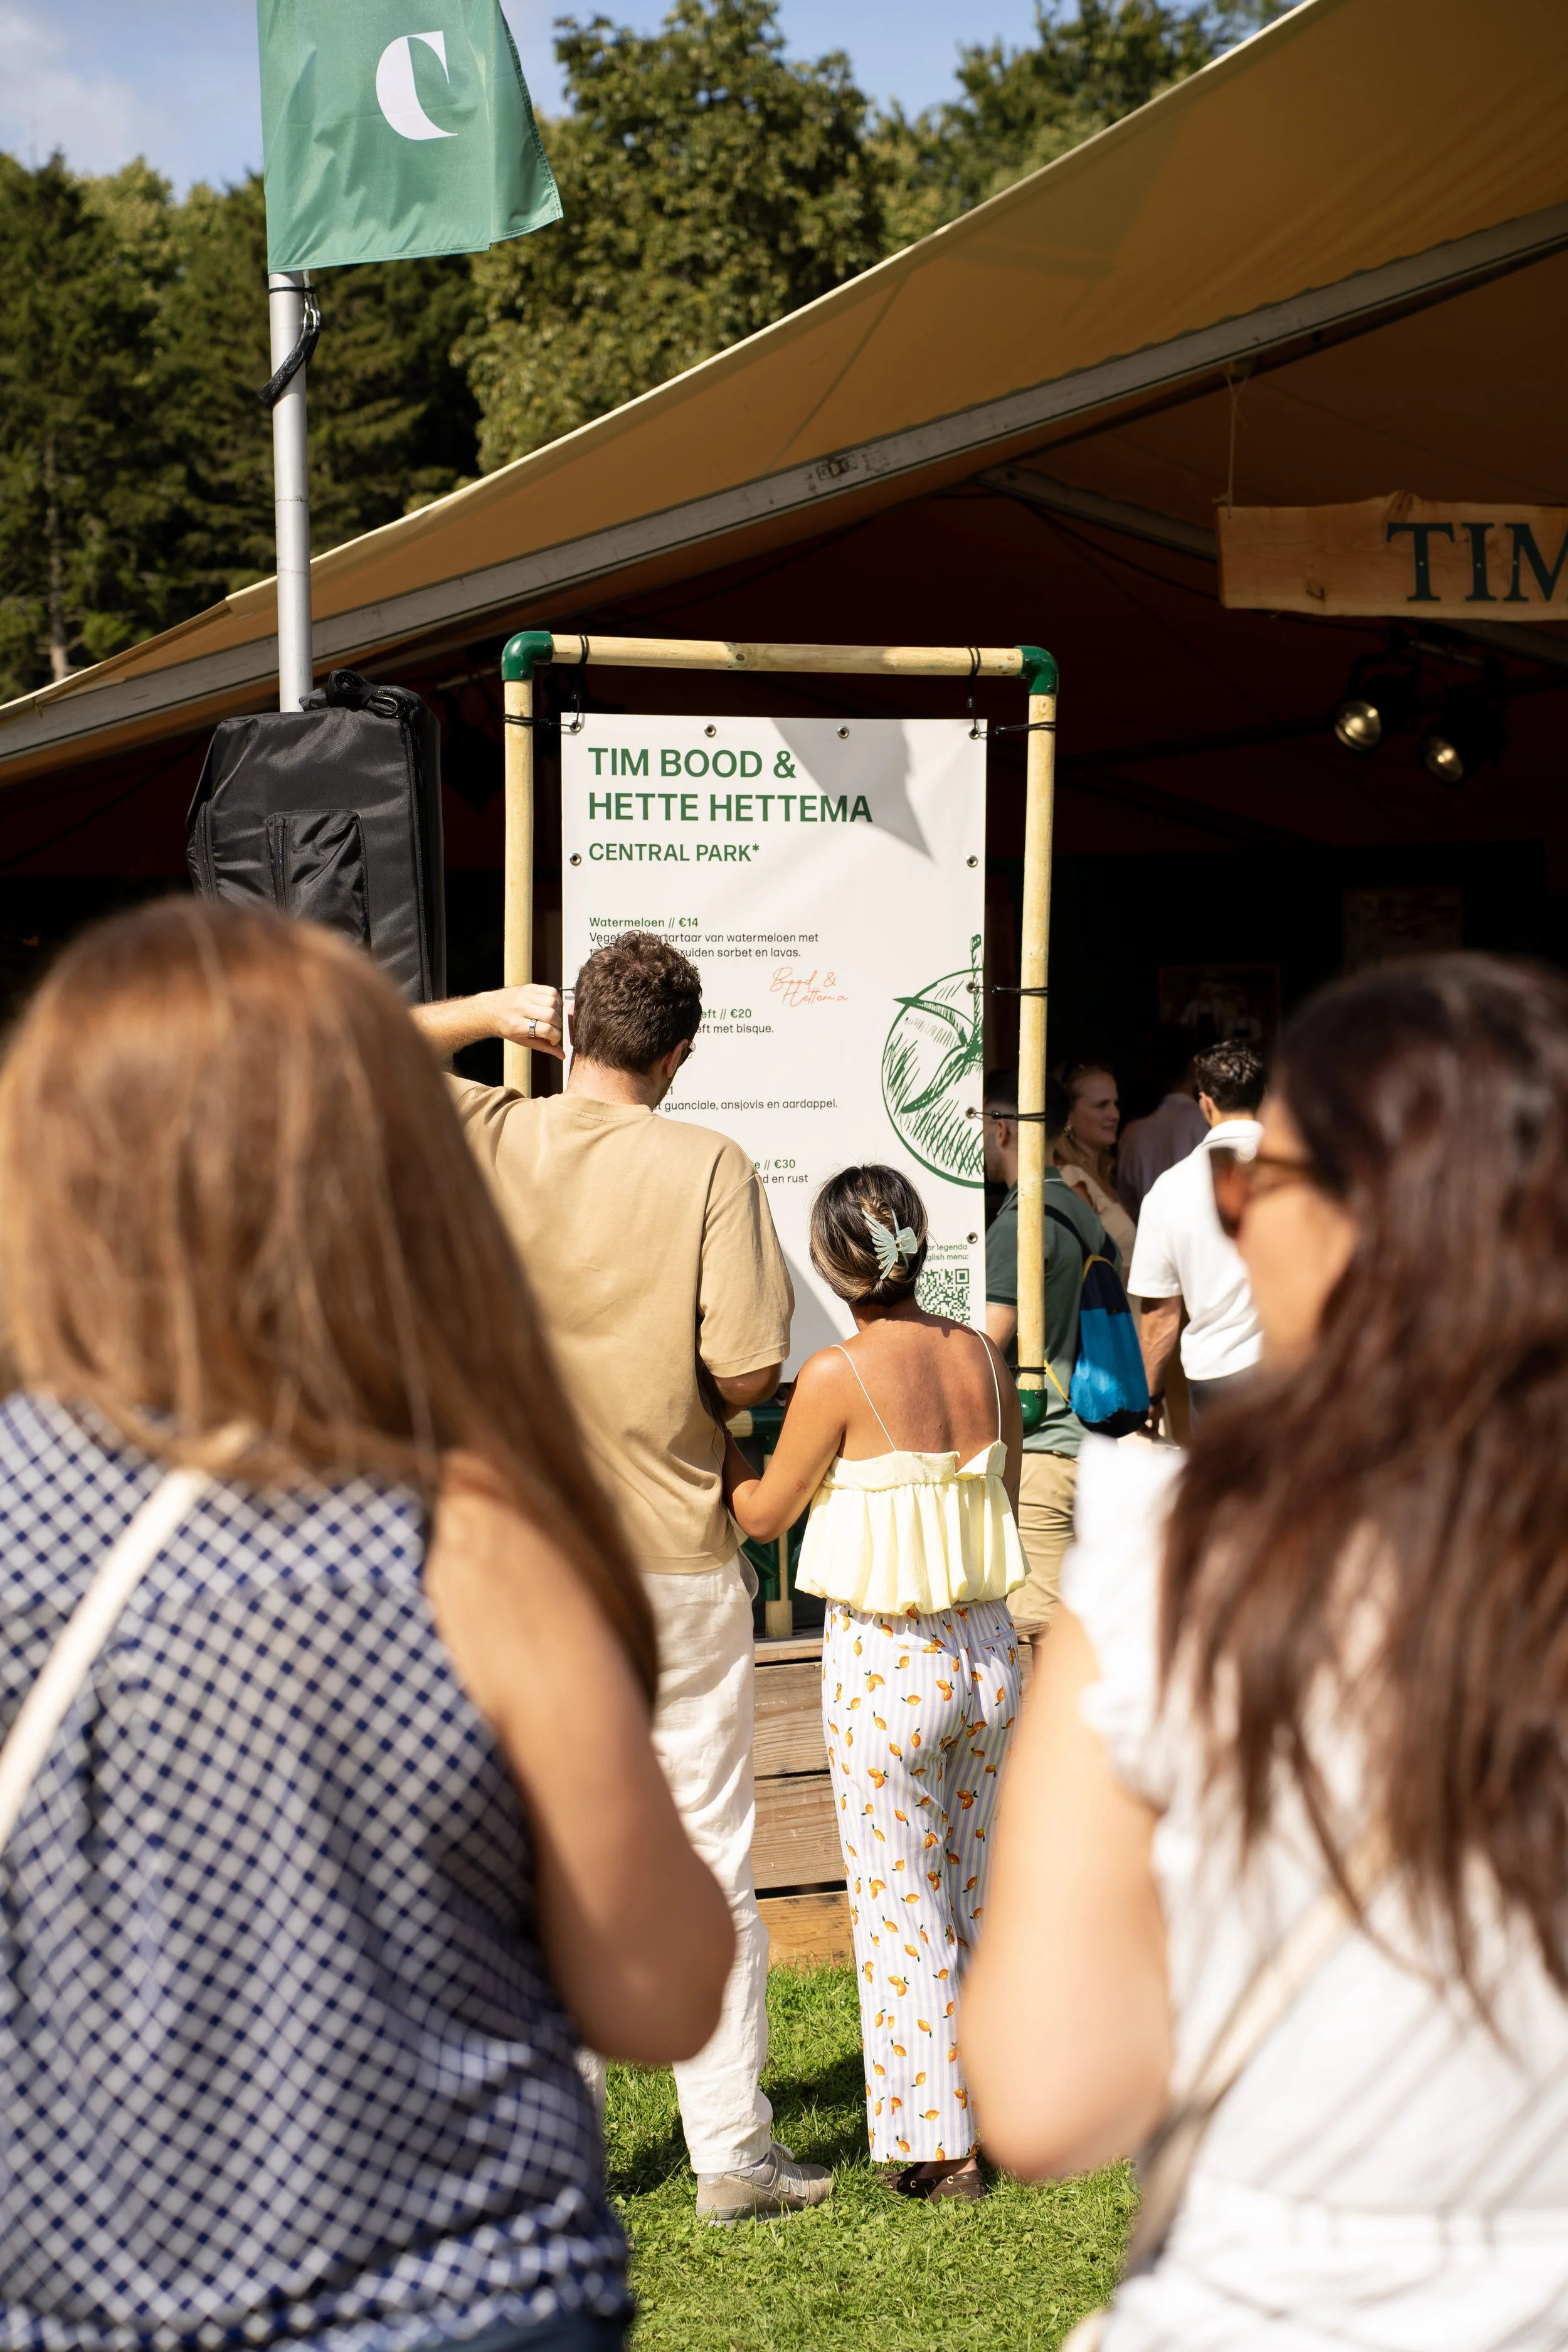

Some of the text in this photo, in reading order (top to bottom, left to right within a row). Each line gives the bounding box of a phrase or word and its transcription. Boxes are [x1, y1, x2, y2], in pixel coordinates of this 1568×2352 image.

[588, 747, 797, 778] TIM BOOD &
[588, 792, 874, 823] HETTE HETTEMA
[588, 843, 691, 862] CENTRAL
[589, 918, 665, 928] Watermeloen
[679, 918, 699, 928] €14
[727, 933, 796, 942] watermeloen
[799, 934, 818, 942] met
[718, 948, 753, 957] sorbet
[771, 948, 801, 957] lavas.
[730, 1009, 752, 1019] €20
[714, 1025, 733, 1033] met
[736, 1024, 774, 1035] bisque.
[665, 1100, 718, 1113] guanciale,
[721, 1100, 764, 1111] ansjovis
[783, 1099, 838, 1110] aardappel.
[774, 1159, 796, 1169] €30
[788, 1174, 808, 1183] rust
[937, 1244, 967, 1252] legenda
[926, 1254, 945, 1262] glish
